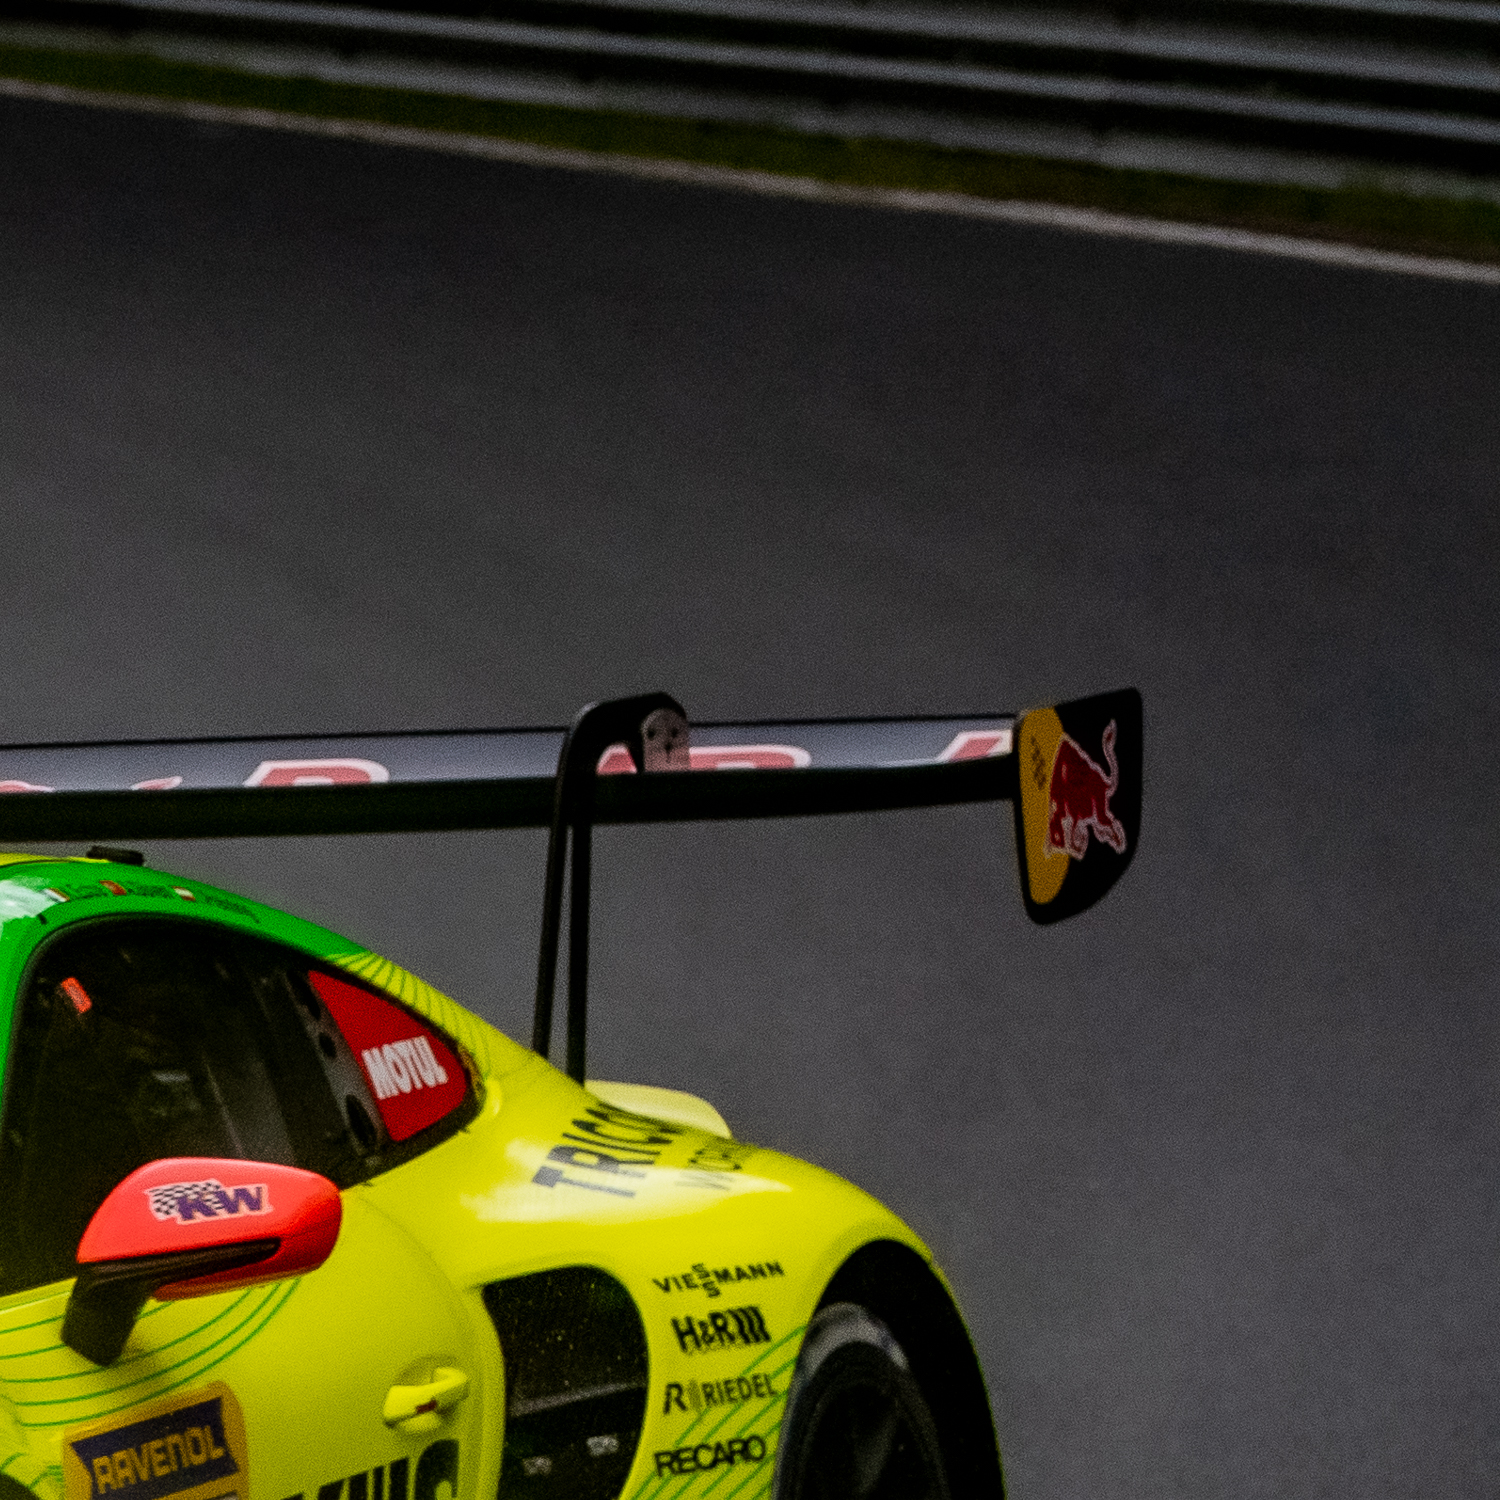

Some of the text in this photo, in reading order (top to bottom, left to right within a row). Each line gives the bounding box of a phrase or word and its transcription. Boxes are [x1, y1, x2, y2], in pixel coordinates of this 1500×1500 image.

[361, 1036, 449, 1100] MOTUL
[92, 1424, 226, 1494] RAVENOL
[653, 1434, 767, 1477] RECARO
